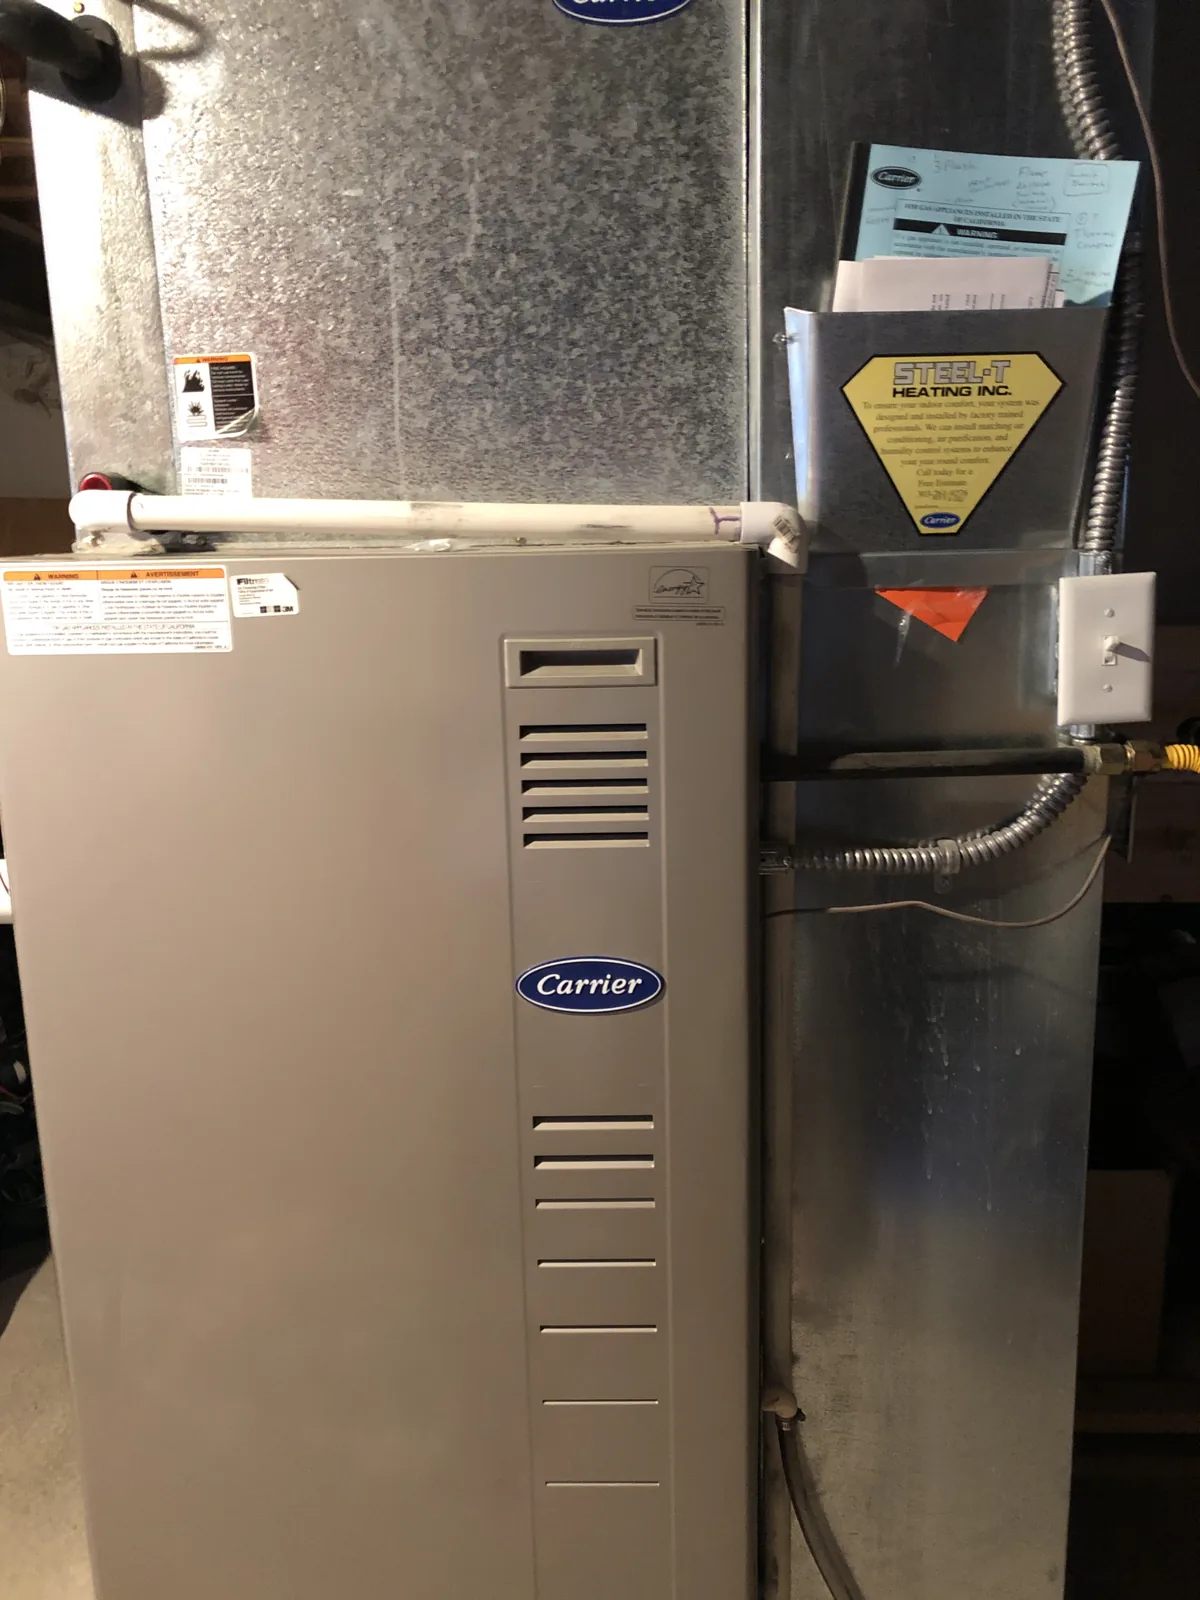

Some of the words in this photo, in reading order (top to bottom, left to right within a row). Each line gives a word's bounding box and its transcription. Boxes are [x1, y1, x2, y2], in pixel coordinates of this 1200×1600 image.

[878, 171, 915, 183] Carrier
[957, 228, 998, 239] WARNING
[892, 386, 972, 398] HEATING
[977, 385, 1013, 397] INC.
[923, 516, 957, 525] Carrier
[145, 570, 200, 578] AVERTISSEMENT
[537, 973, 642, 995] Carrier
